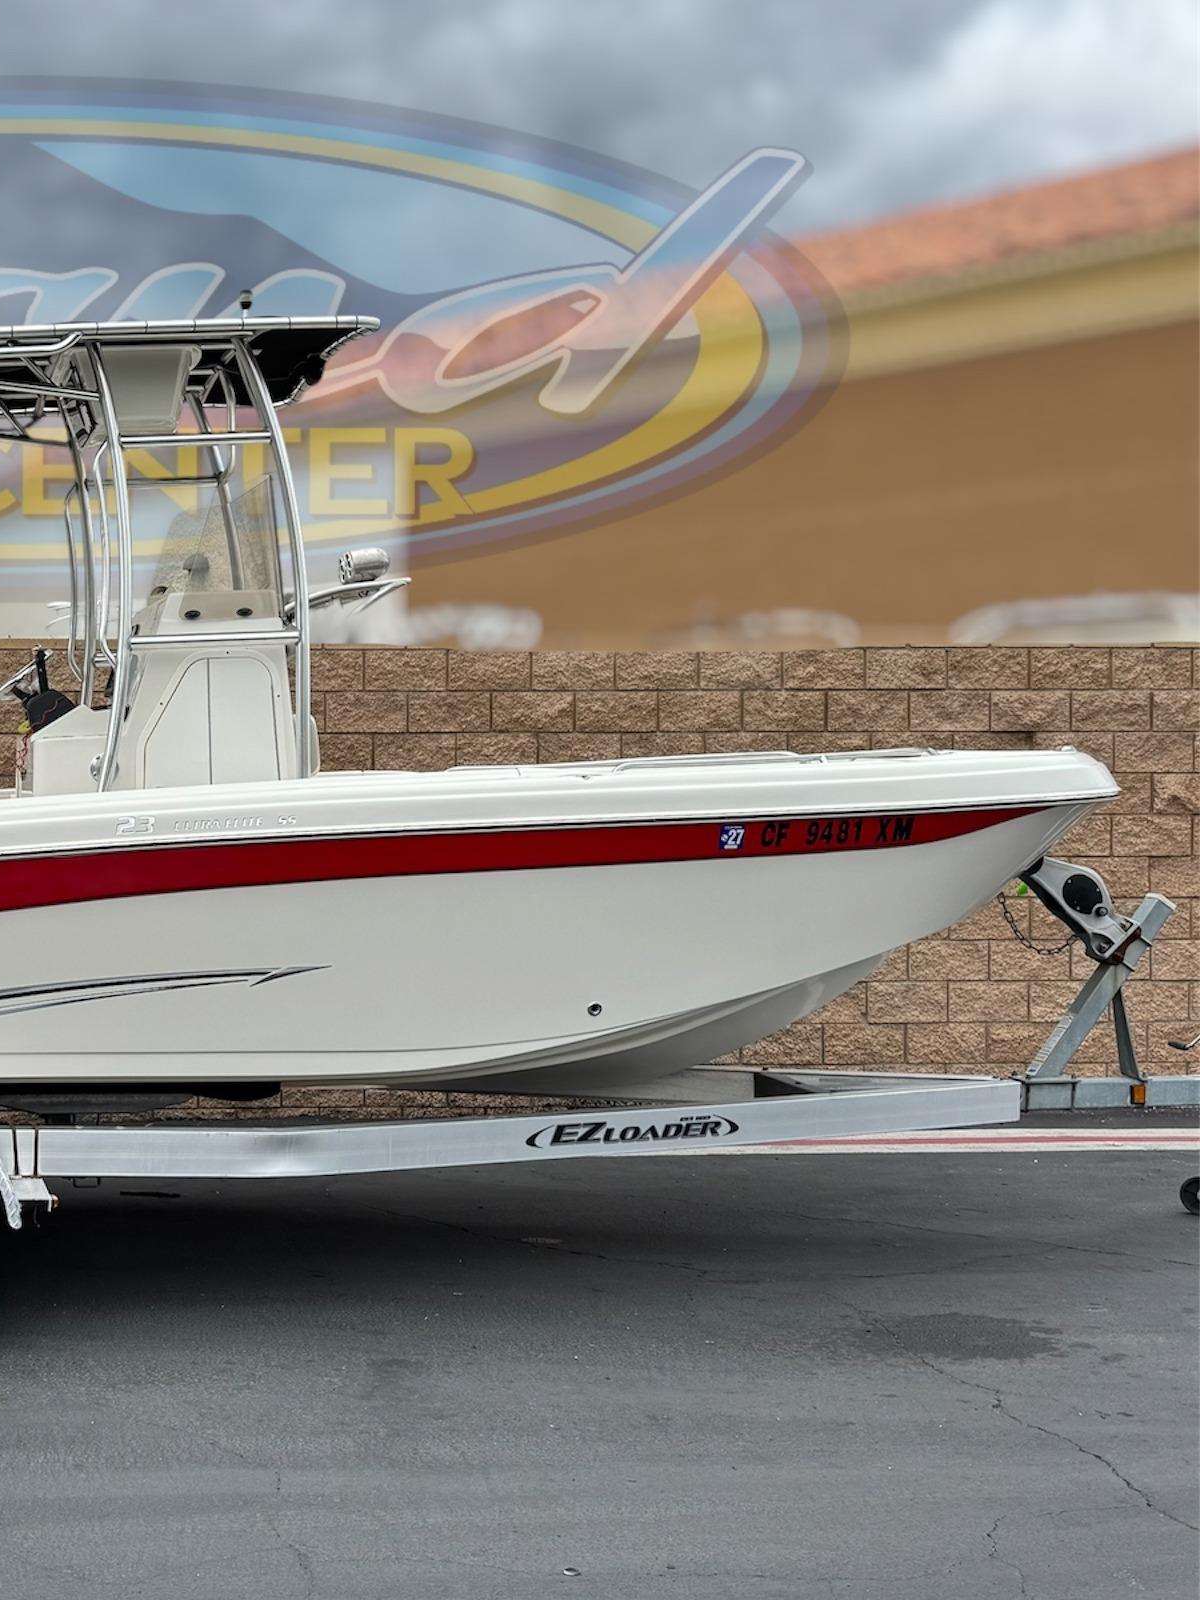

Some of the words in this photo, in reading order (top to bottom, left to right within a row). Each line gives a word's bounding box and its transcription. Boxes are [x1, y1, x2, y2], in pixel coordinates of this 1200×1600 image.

[115, 816, 156, 835] 23
[761, 821, 791, 847] CF
[805, 819, 863, 845] 9481
[876, 816, 915, 842] XM
